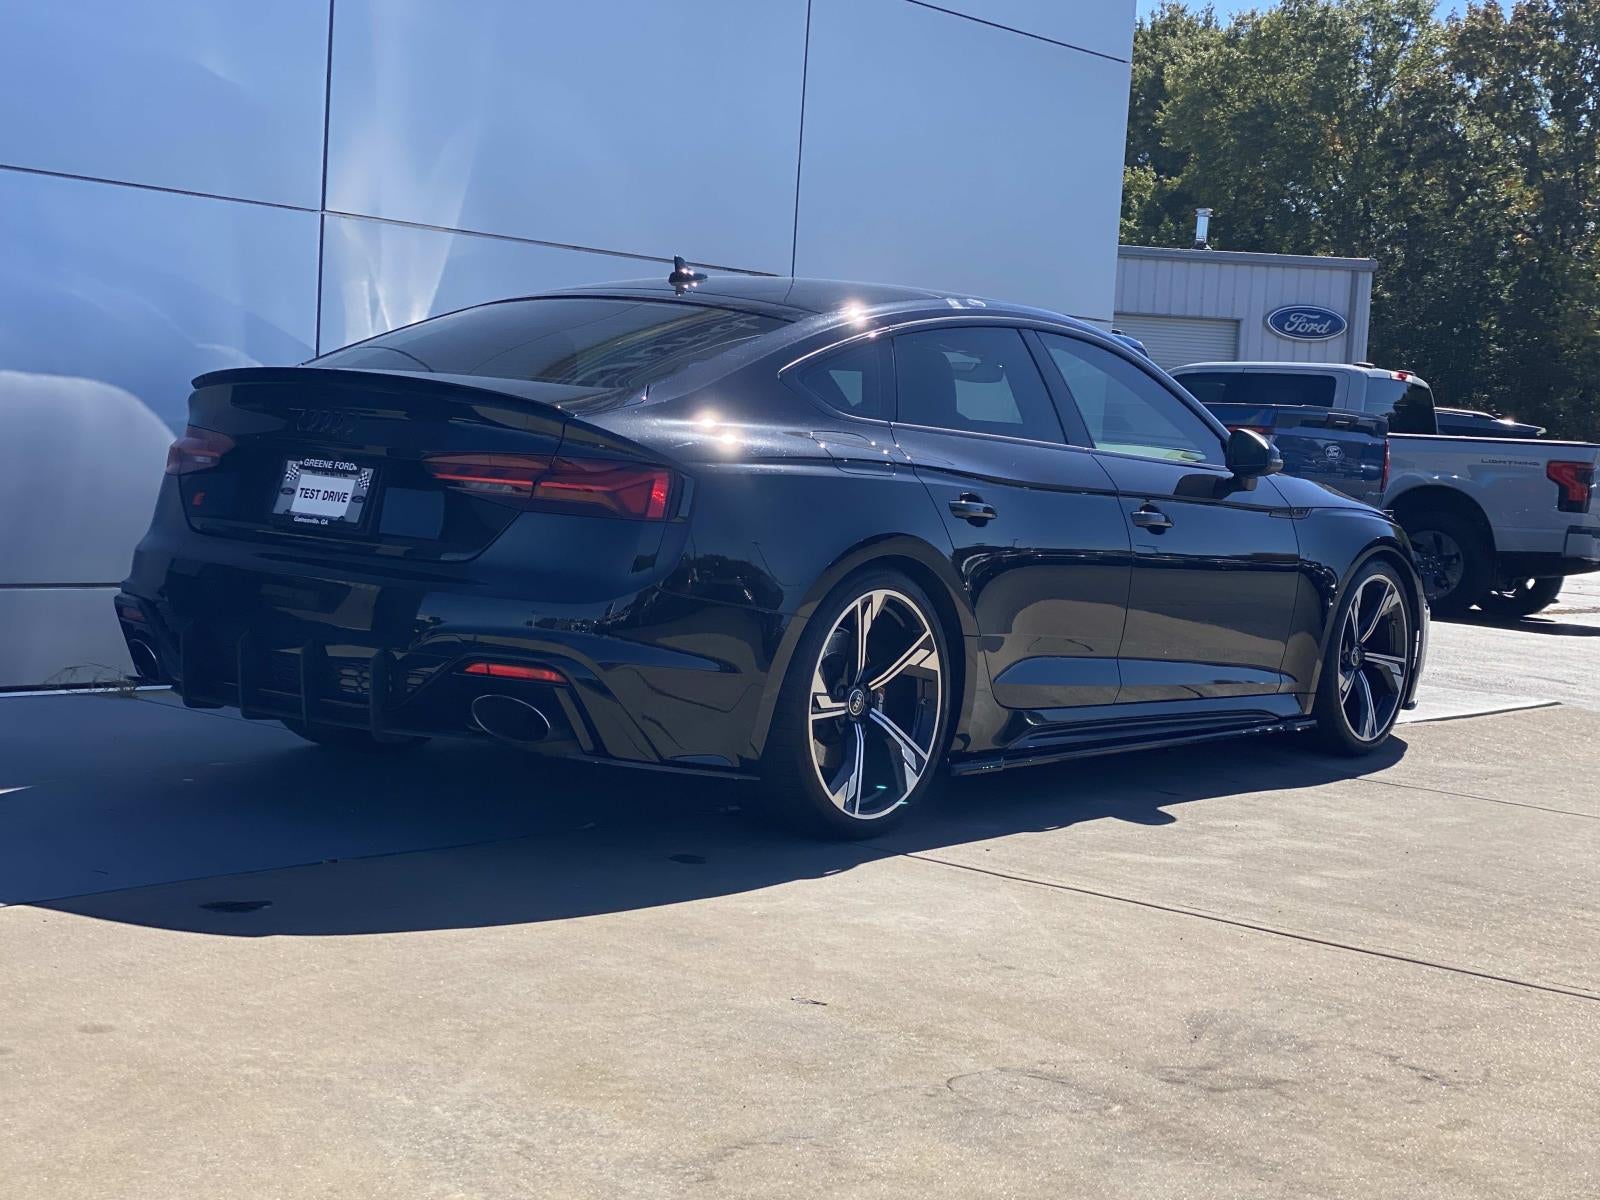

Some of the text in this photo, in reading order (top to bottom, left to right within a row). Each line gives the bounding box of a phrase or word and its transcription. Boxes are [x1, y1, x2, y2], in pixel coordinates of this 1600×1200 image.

[1284, 312, 1332, 334] Ford
[303, 458, 354, 471] GREENE FORD
[299, 487, 321, 500] TEST
[322, 490, 349, 503] DRIVE
